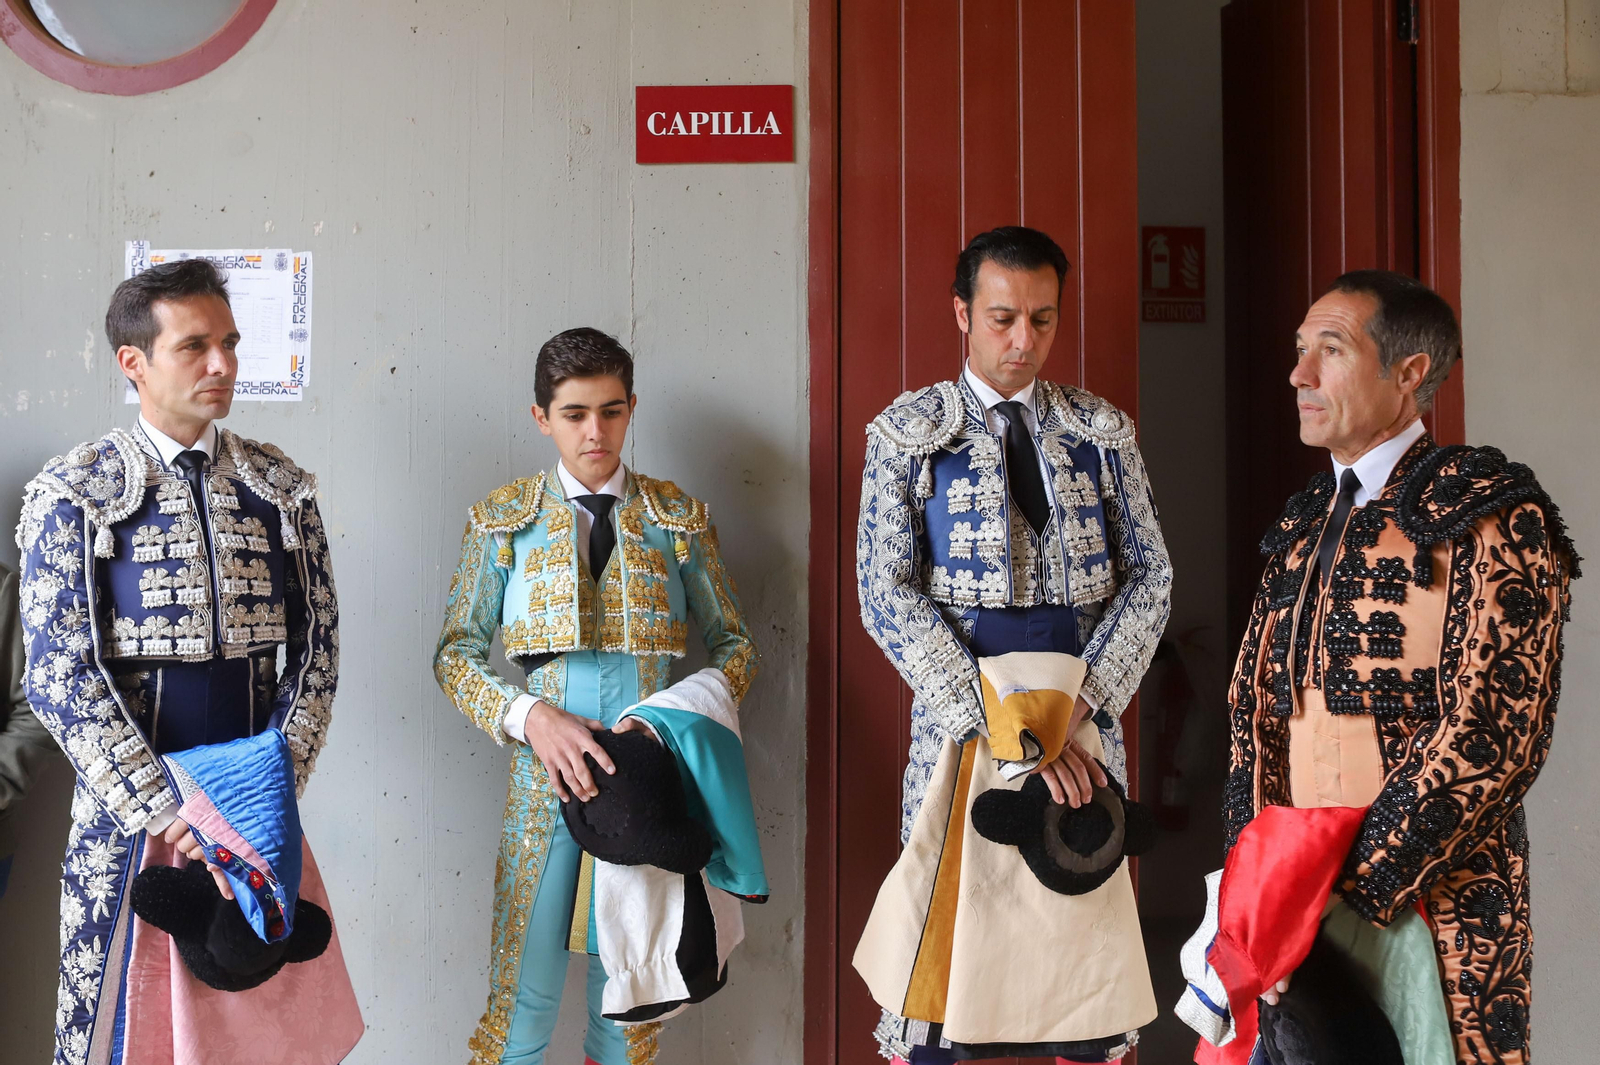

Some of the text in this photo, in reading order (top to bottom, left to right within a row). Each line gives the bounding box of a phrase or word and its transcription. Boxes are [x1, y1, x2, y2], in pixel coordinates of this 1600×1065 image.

[646, 111, 782, 136] CAPILLA
[292, 273, 300, 324] POLICIA
[299, 257, 308, 324] NACIONAL
[1145, 303, 1202, 320] EXTINTOR
